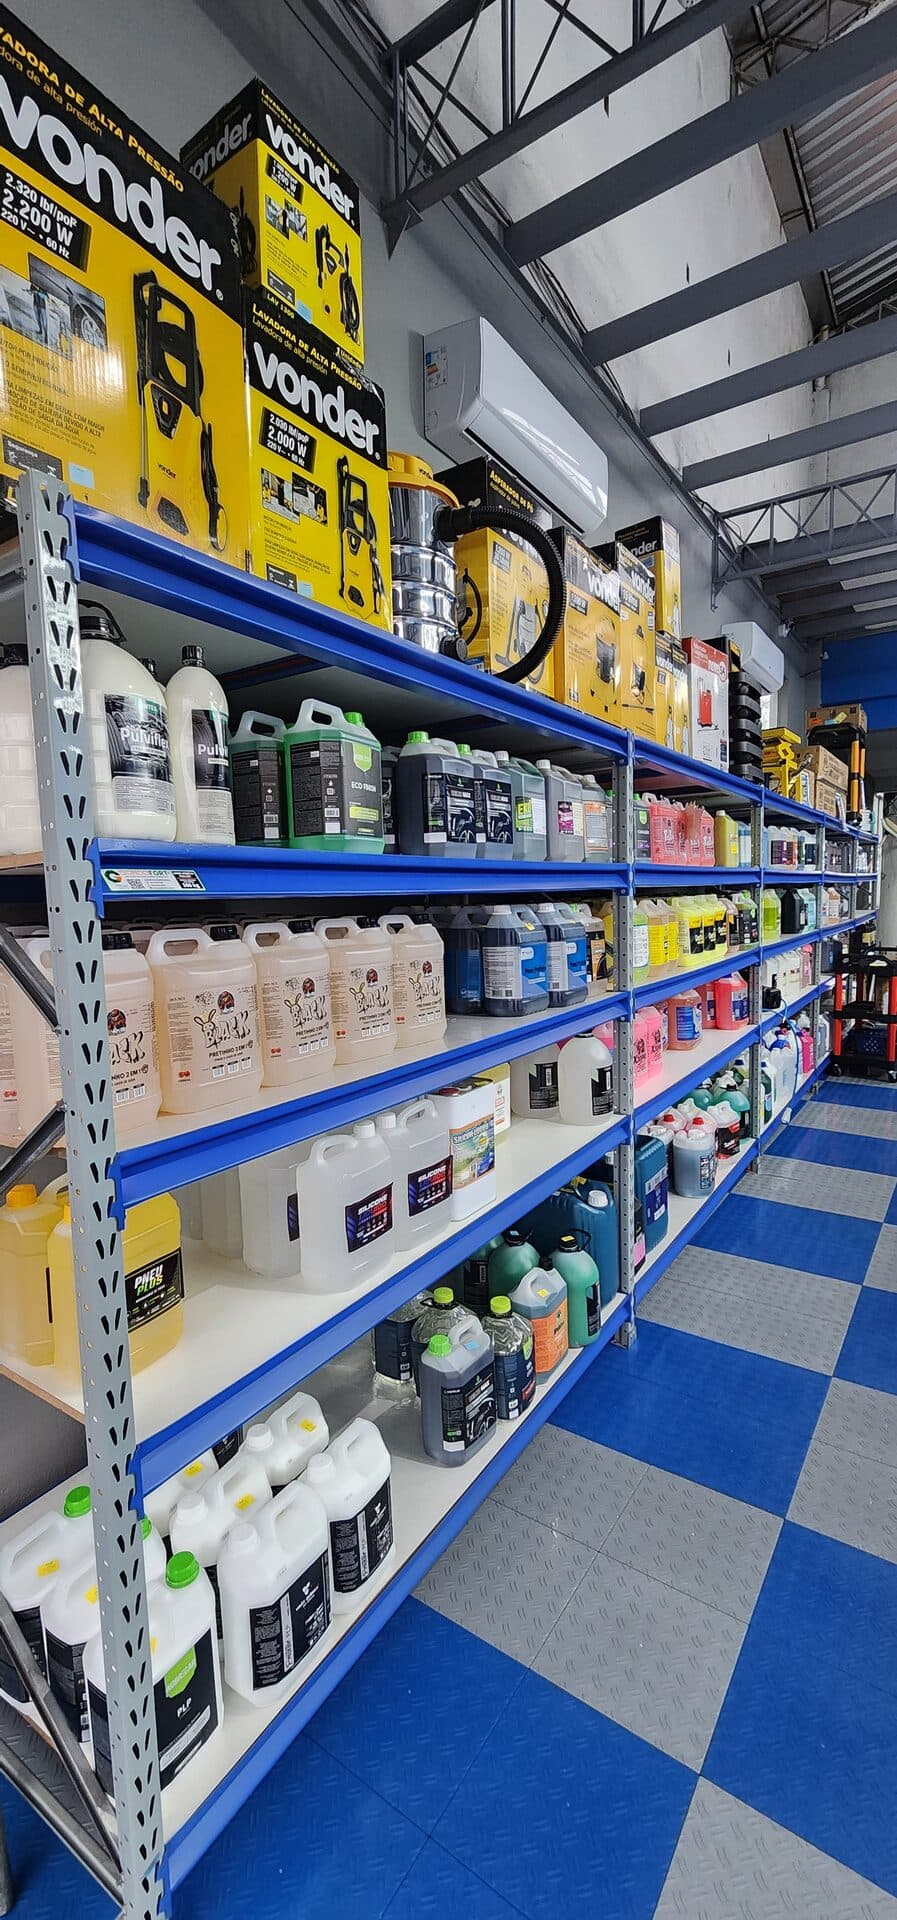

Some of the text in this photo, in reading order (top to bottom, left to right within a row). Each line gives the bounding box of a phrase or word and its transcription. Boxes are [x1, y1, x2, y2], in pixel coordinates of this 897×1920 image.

[0, 26, 184, 193] ADORA DE ALTA PRESSÃO
[26, 67, 41, 86] de
[43, 83, 64, 105] alta
[65, 103, 103, 137] presión
[189, 112, 253, 180] onder
[0, 74, 222, 291] vonder
[265, 113, 354, 221] vonder
[5, 172, 38, 204] 2.320
[3, 188, 74, 247] 2.200 W
[59, 245, 70, 259] Hz
[252, 316, 283, 344] Lavadora
[252, 303, 362, 391] LAVADORA DE ALTA PRESSÃO
[253, 341, 380, 456] vonder
[267, 426, 308, 458] 2.000 W
[120, 726, 170, 750] Pulvifle
[202, 1009, 251, 1049] BLACK
[208, 1047, 235, 1058] PRETINHO
[134, 1263, 164, 1290] PNEU
[136, 1274, 164, 1297] PLUS
[177, 1696, 192, 1718] PLP
